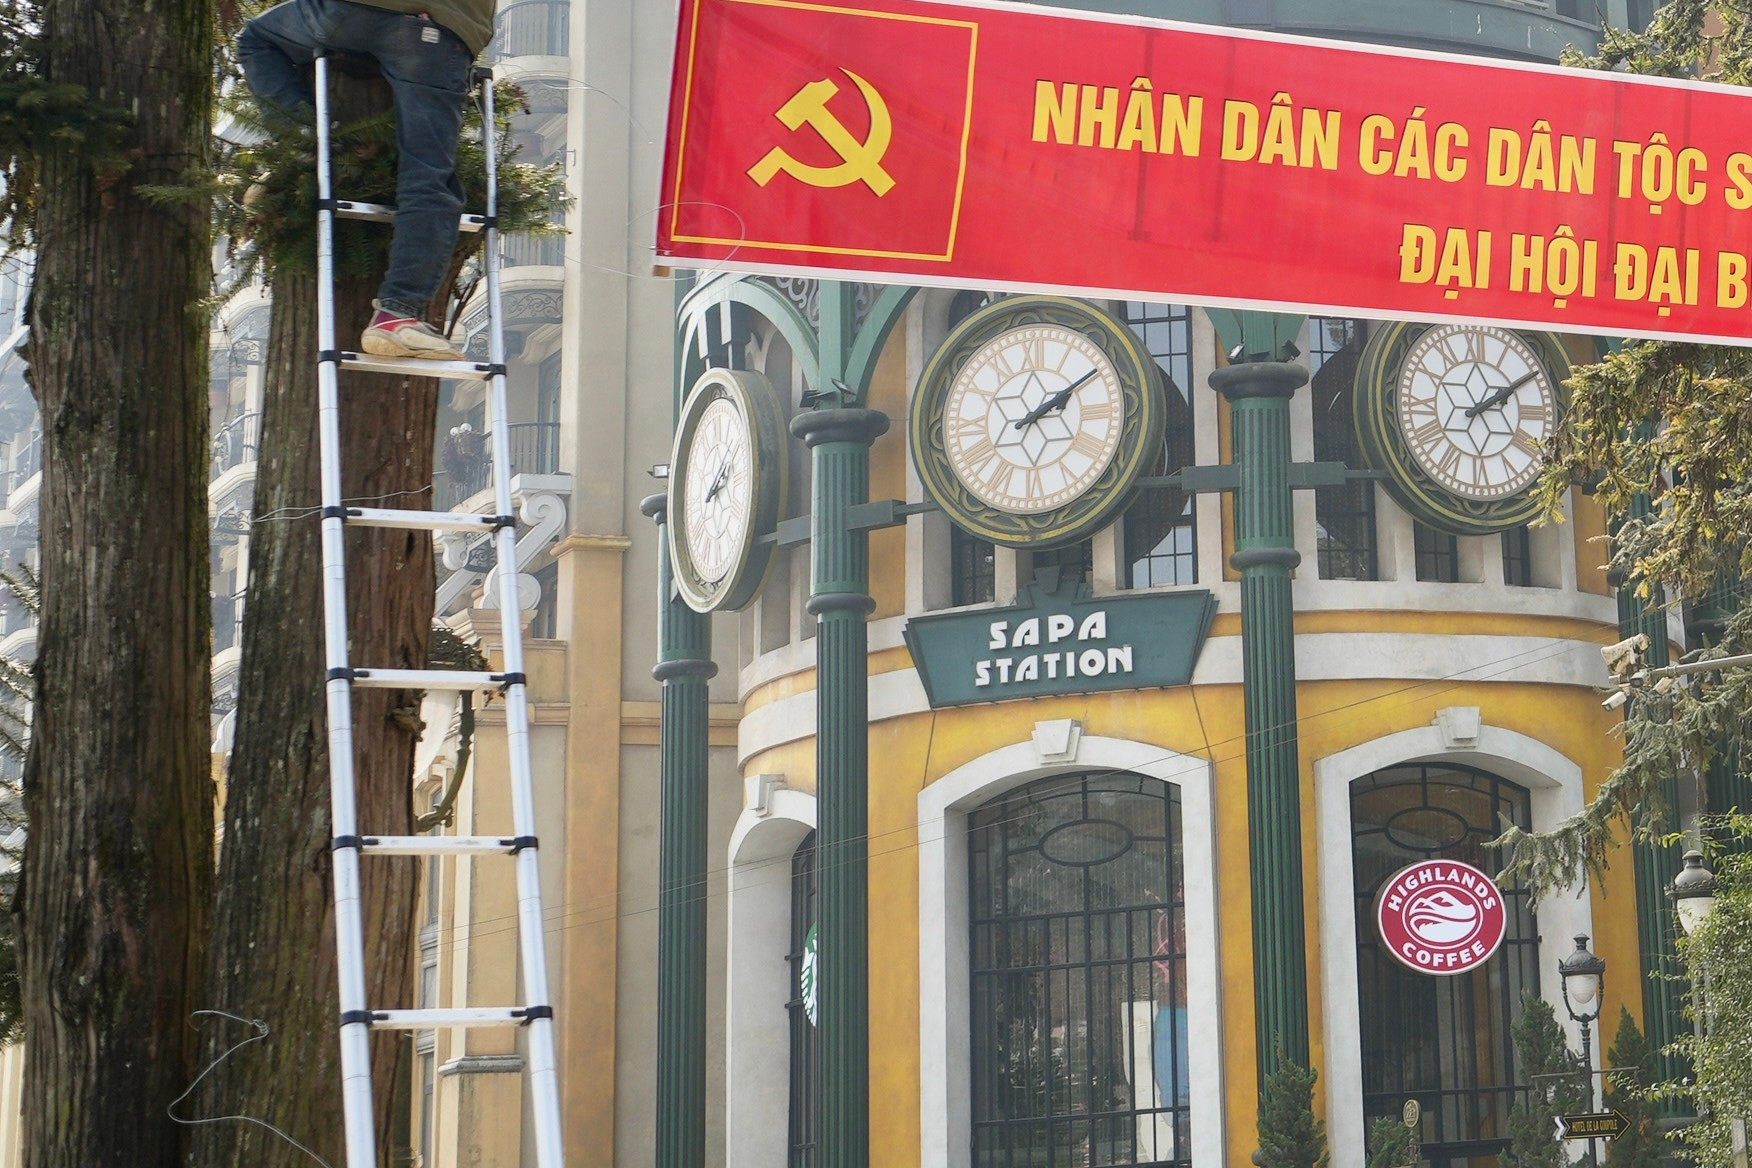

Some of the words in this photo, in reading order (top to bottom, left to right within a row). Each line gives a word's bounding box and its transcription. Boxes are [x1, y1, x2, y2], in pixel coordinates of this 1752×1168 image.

[1033, 78, 1203, 157] NHÂN
[1222, 93, 1341, 170] DÂN
[1360, 107, 1469, 182] CÁC
[1487, 121, 1596, 194] DÂN
[1614, 133, 1707, 214] TỘC
[1400, 224, 1491, 299] ĐẠI
[1510, 225, 1597, 308] HỘI
[1614, 243, 1699, 316] ĐẠI
[989, 611, 1107, 650] SAPA
[975, 645, 1133, 687] STATION
[1388, 867, 1496, 911] HIGHLANDS
[1402, 940, 1486, 967] COFFEE
